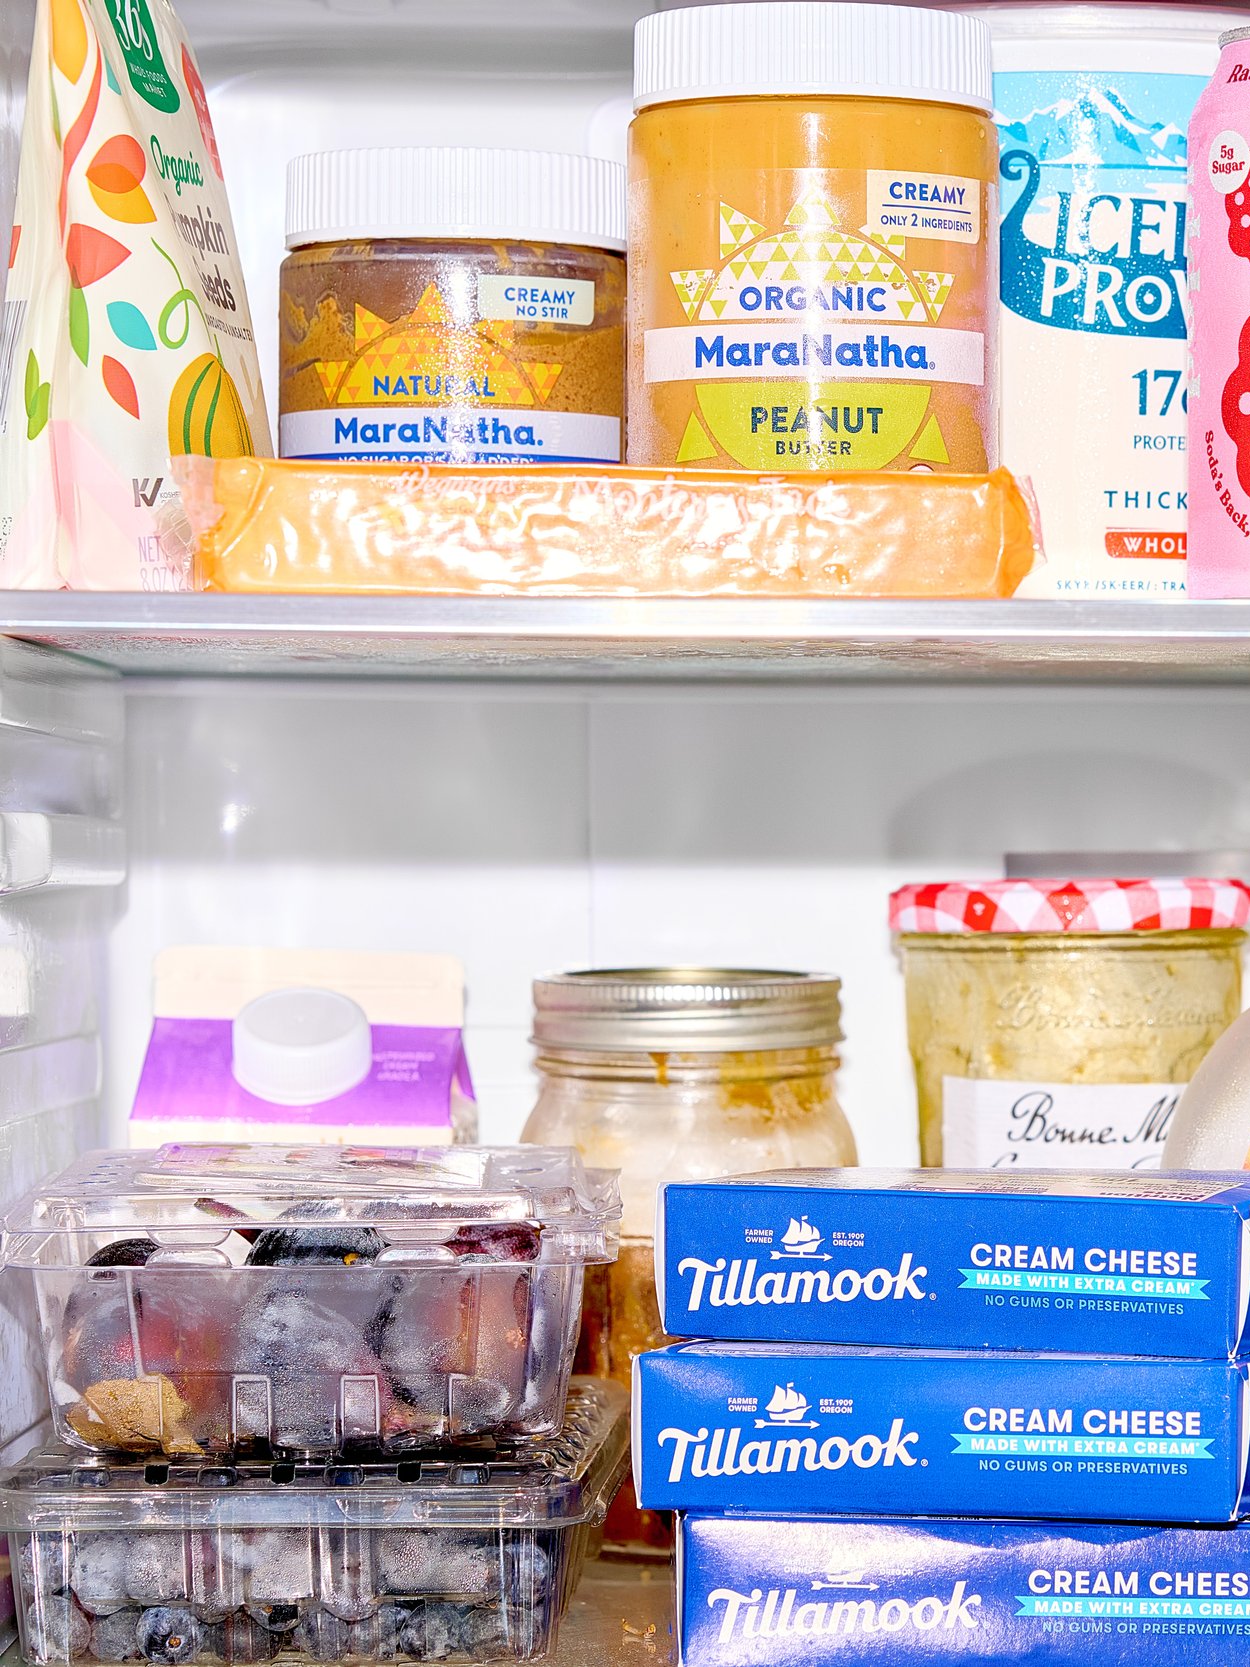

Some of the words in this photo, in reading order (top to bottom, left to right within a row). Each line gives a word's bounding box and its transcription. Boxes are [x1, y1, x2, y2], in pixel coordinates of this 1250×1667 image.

[1220, 145, 1234, 160] 5g
[150, 134, 204, 196] Organic
[1212, 160, 1245, 174] Sugar
[889, 181, 966, 206] CREAMY
[880, 214, 908, 228] ONLY
[911, 213, 919, 228] 2
[921, 217, 972, 233] INGREDIENTS
[504, 287, 576, 305] CREAMY
[739, 286, 887, 312] ORGANIC
[516, 305, 538, 317] NO
[542, 307, 568, 319] STIR
[373, 376, 496, 398] NATURAL
[751, 406, 883, 435] PEANUT
[775, 441, 852, 456] BUTTER
[1133, 435, 1186, 451] PROTE
[1205, 430, 1223, 492] Soda's
[1219, 489, 1250, 538] Back,
[1104, 491, 1187, 509] THICK
[1007, 1091, 1117, 1144] Bonne
[744, 1229, 774, 1237] FARMER
[745, 1236, 773, 1244] OWNED
[848, 1232, 865, 1240] 1909
[832, 1239, 865, 1248] OREGON
[970, 1243, 1075, 1271] CREAM
[1084, 1248, 1197, 1277] CHEESE
[677, 1253, 928, 1312] Tillamook
[976, 1273, 1021, 1288] MADE
[1026, 1275, 1069, 1290] WITH
[1075, 1277, 1126, 1292] EXTRA
[985, 1295, 1005, 1306] NO
[1010, 1296, 1050, 1309] GUMS
[1054, 1298, 1074, 1310] OR
[1079, 1299, 1185, 1315] PRESERVATIVES
[728, 1397, 758, 1405] FARMER
[820, 1406, 853, 1414] OREGON
[835, 1399, 853, 1407] 1909
[963, 1407, 1073, 1434] CREAM
[1083, 1409, 1201, 1436] CHEESE
[657, 1418, 920, 1483] Tillamook
[971, 1439, 1020, 1453] MADE
[1024, 1440, 1069, 1454] WITH
[1074, 1440, 1128, 1455] EXTRA
[979, 1460, 1001, 1471] NO
[1004, 1460, 1048, 1472] GUMS
[1052, 1461, 1074, 1473] OR
[1078, 1462, 1188, 1475] PRESERVATIVES
[1028, 1569, 1138, 1595] CREAM
[707, 1581, 982, 1644] Tillamook
[1034, 1601, 1083, 1614] MADE
[1088, 1602, 1133, 1615] WITH
[1139, 1602, 1192, 1615] EXTRA
[1042, 1622, 1065, 1633] NO
[1068, 1622, 1112, 1634] GUMS
[1117, 1623, 1137, 1634] OR
